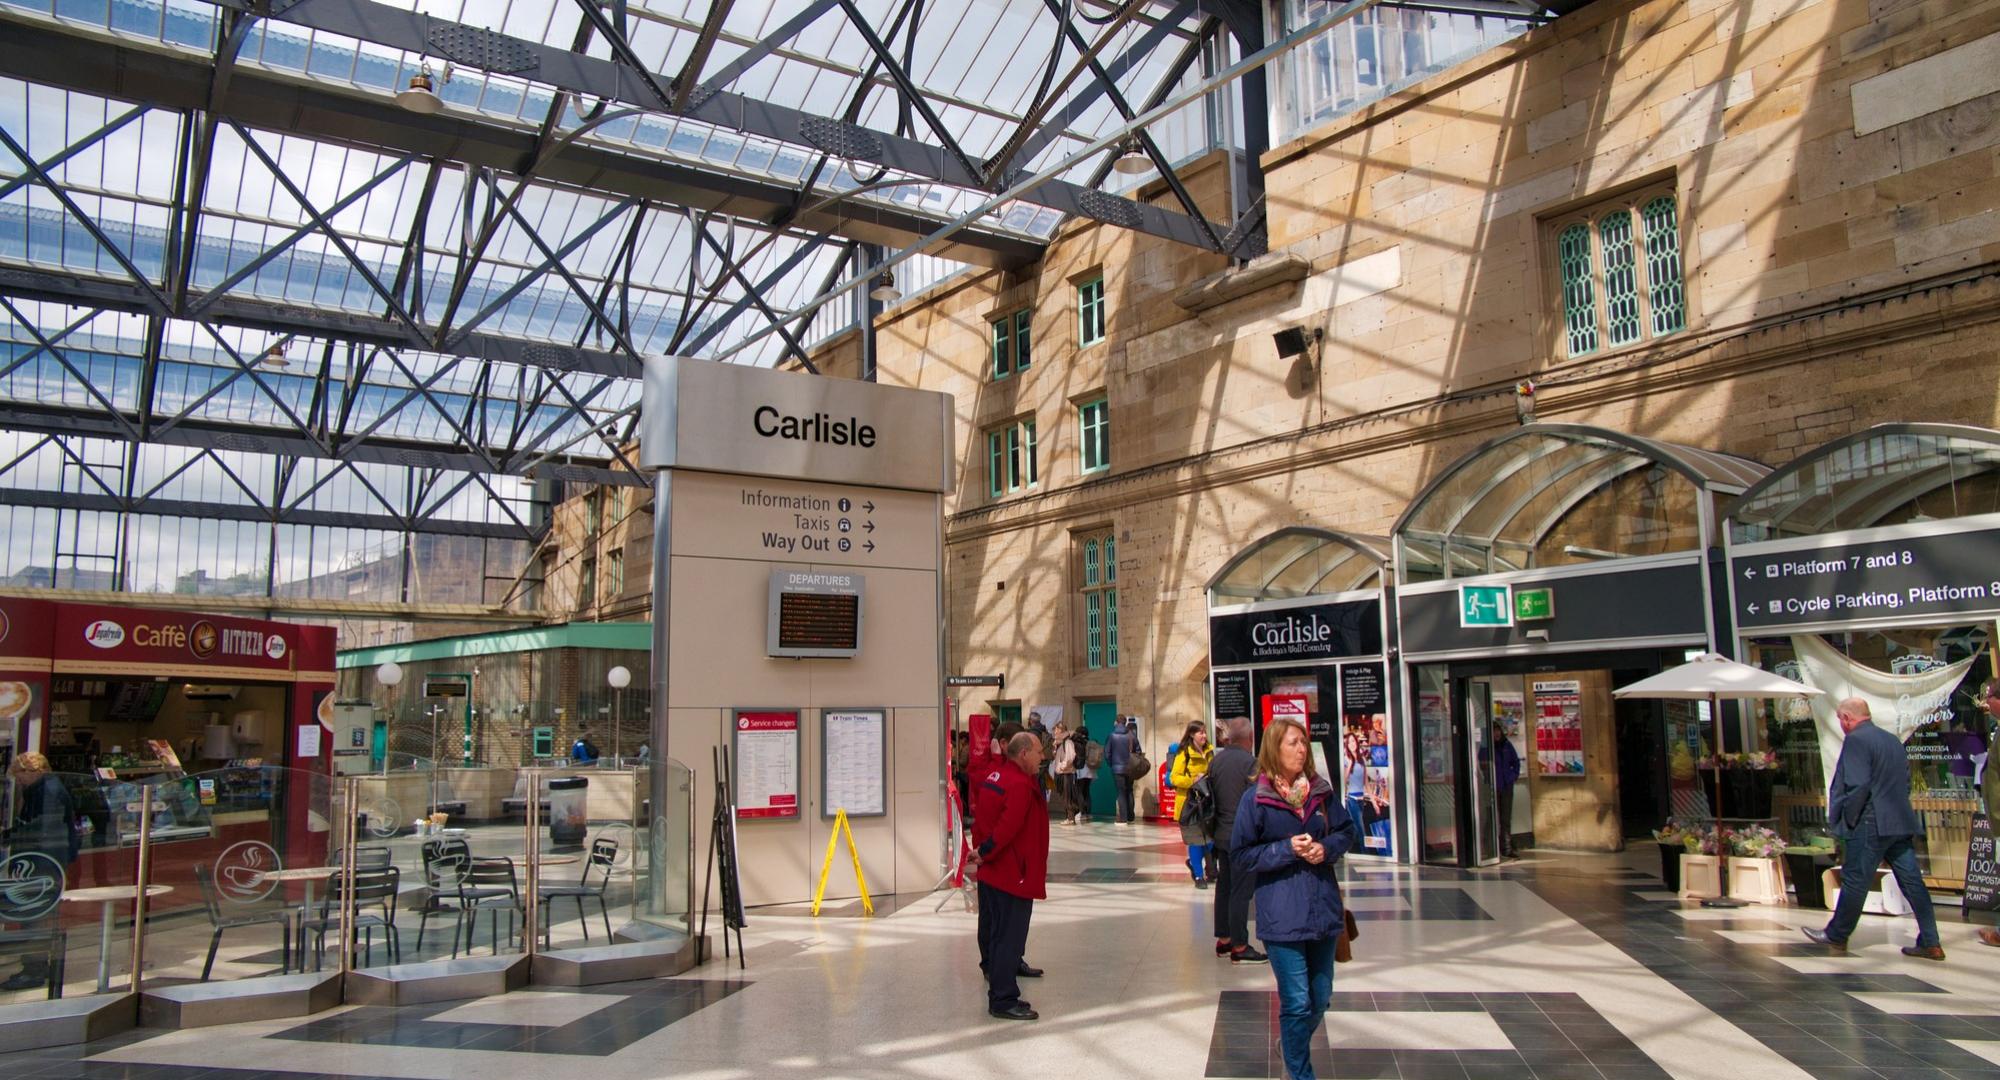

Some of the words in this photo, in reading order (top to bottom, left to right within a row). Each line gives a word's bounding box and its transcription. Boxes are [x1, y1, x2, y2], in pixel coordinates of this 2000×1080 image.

[754, 405, 876, 448] Carlisle
[741, 489, 831, 511] Information
[794, 513, 830, 531] Taxis
[762, 532, 796, 553] Way
[801, 533, 830, 551] Out
[1783, 559, 1847, 577] Platform
[1852, 556, 1861, 569] 7
[1866, 551, 1896, 569] and
[1902, 551, 1913, 565] 8
[789, 573, 851, 586] DEPARTURES
[1786, 595, 1831, 614] Cycle
[1835, 591, 1904, 609] Parking,
[1909, 584, 1985, 603] Platform
[1990, 581, 2000, 596] 8
[1252, 614, 1331, 646] Carlisle
[132, 625, 186, 648] Caffè
[222, 629, 263, 656] RITAZZA
[1252, 648, 1259, 656] &
[1288, 643, 1303, 654] Wall
[1303, 643, 1332, 653] Country
[750, 719, 771, 727] Service
[772, 719, 795, 728] changes
[1971, 842, 1992, 853] CUPS
[1967, 873, 2000, 886] COMPOSTA
[1966, 891, 1989, 903] PLANTS
